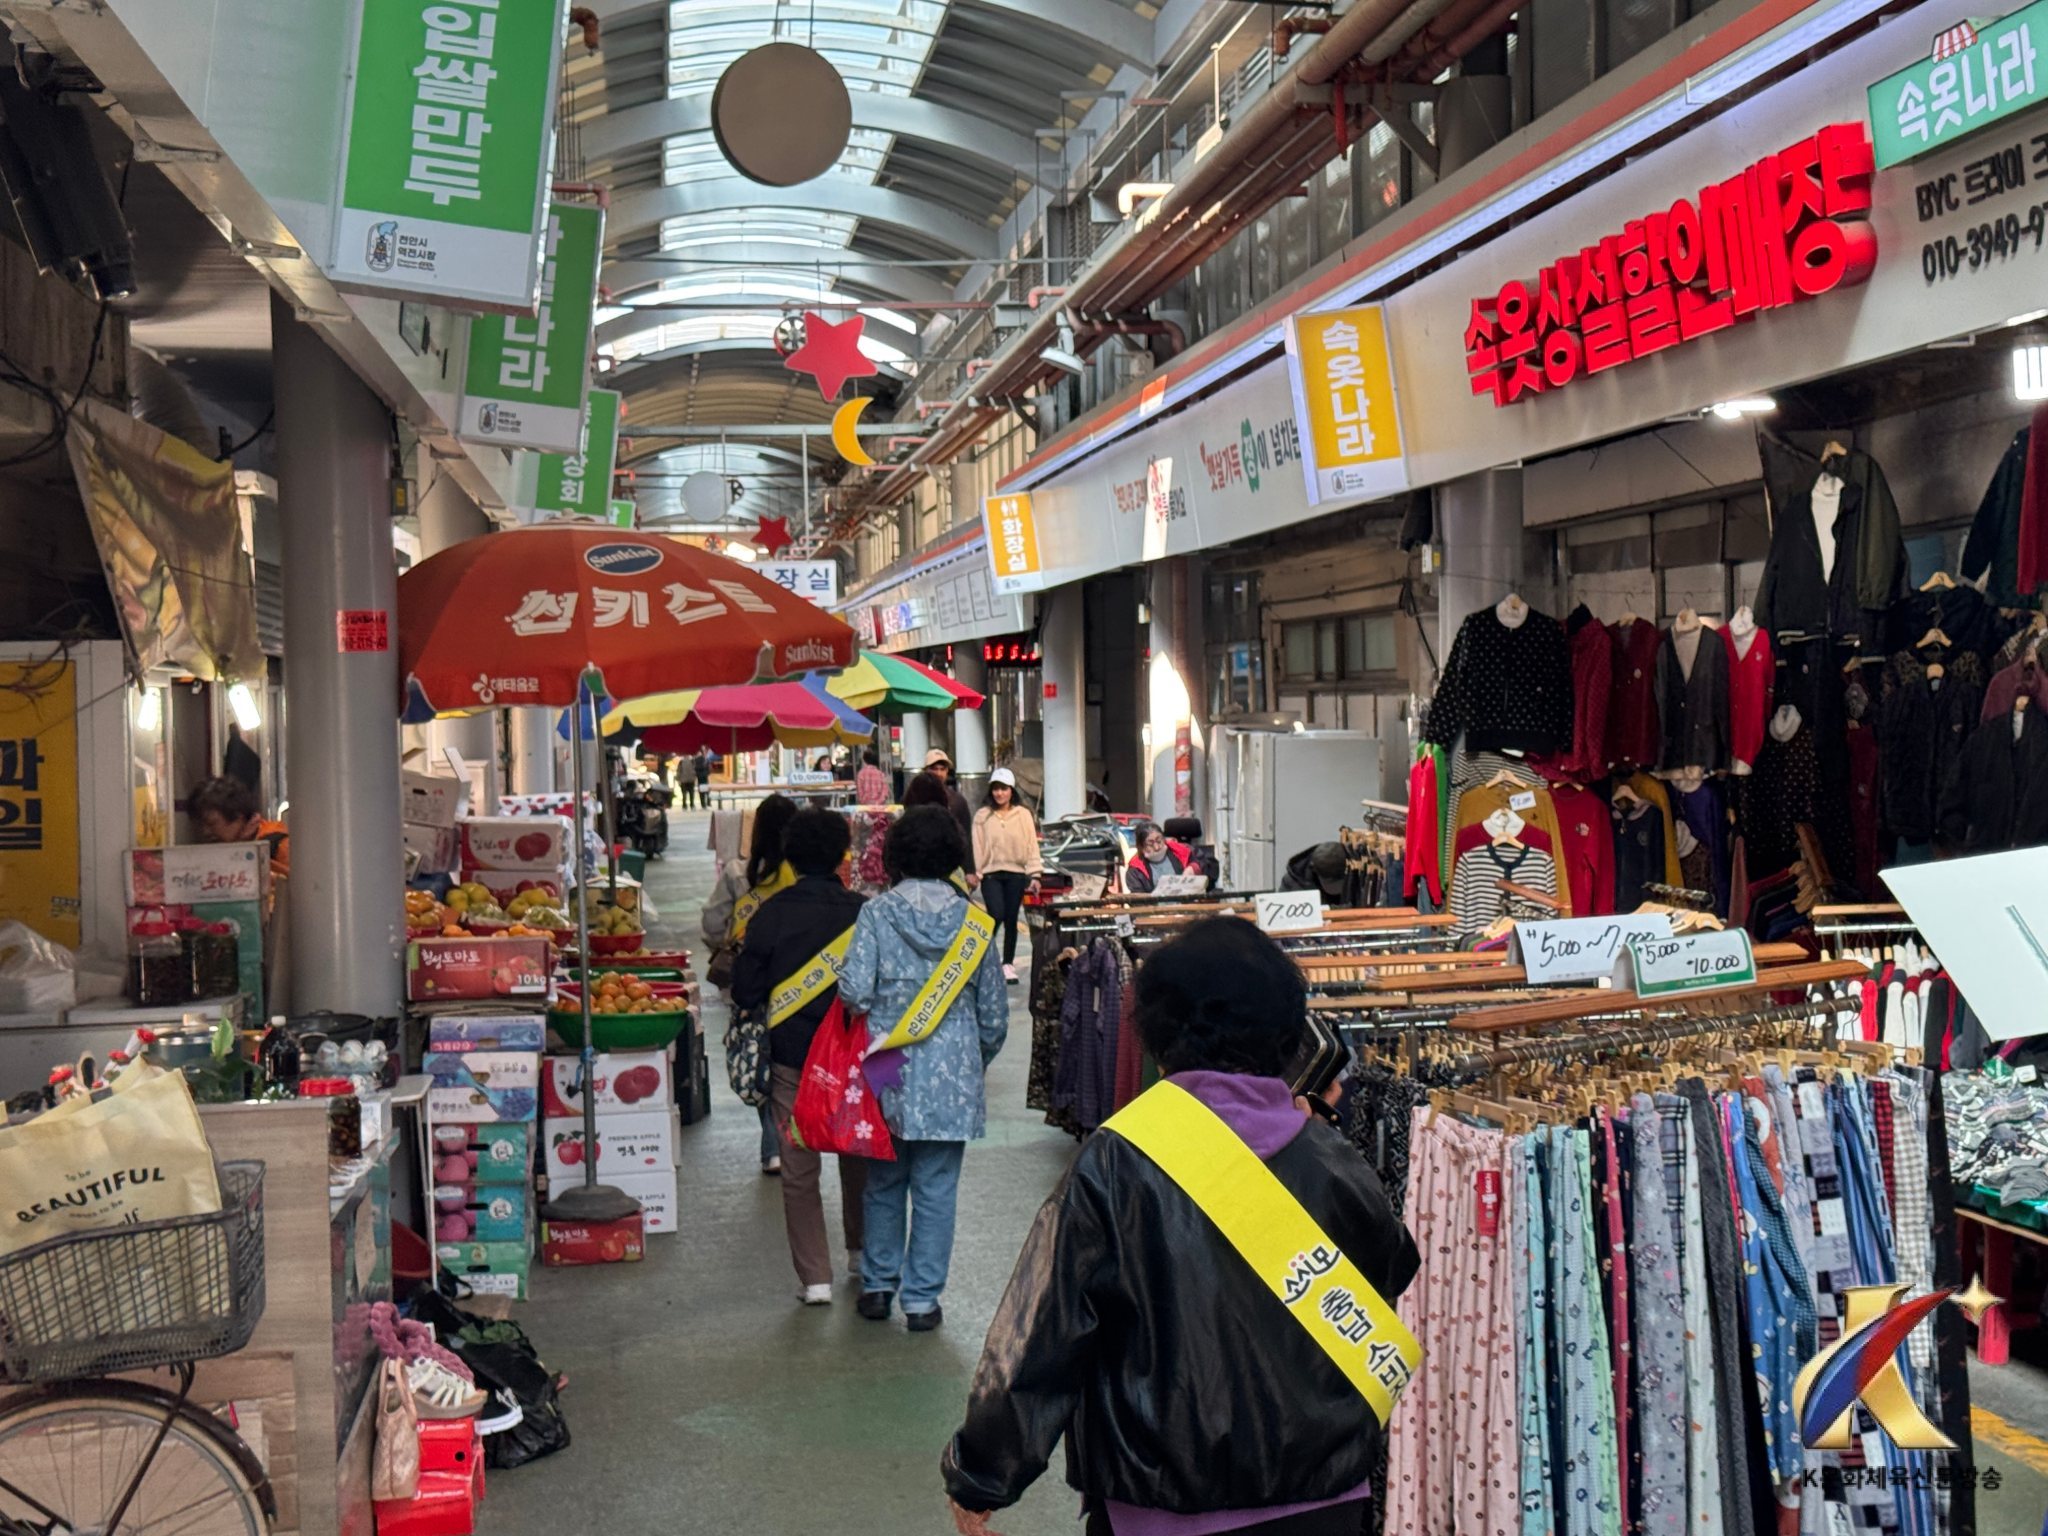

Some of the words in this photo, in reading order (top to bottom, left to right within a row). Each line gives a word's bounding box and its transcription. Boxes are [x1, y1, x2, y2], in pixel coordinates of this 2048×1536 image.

[404, 0, 498, 206] 입쌀만두
[1897, 23, 2037, 142] 속옷나라
[1915, 172, 1960, 223] BYC
[1464, 121, 1879, 408] 속옷상설할인매장
[1921, 199, 2048, 283] 010-3949-9
[1322, 320, 1376, 458] 속옷나라
[589, 548, 660, 568] Sunkist
[1001, 517, 1028, 572] 화장실
[759, 567, 830, 592] 장실
[785, 639, 835, 666] Sunkist
[16, 1167, 165, 1223] BEAUTIFUL
[1321, 1288, 1374, 1344] 충남
